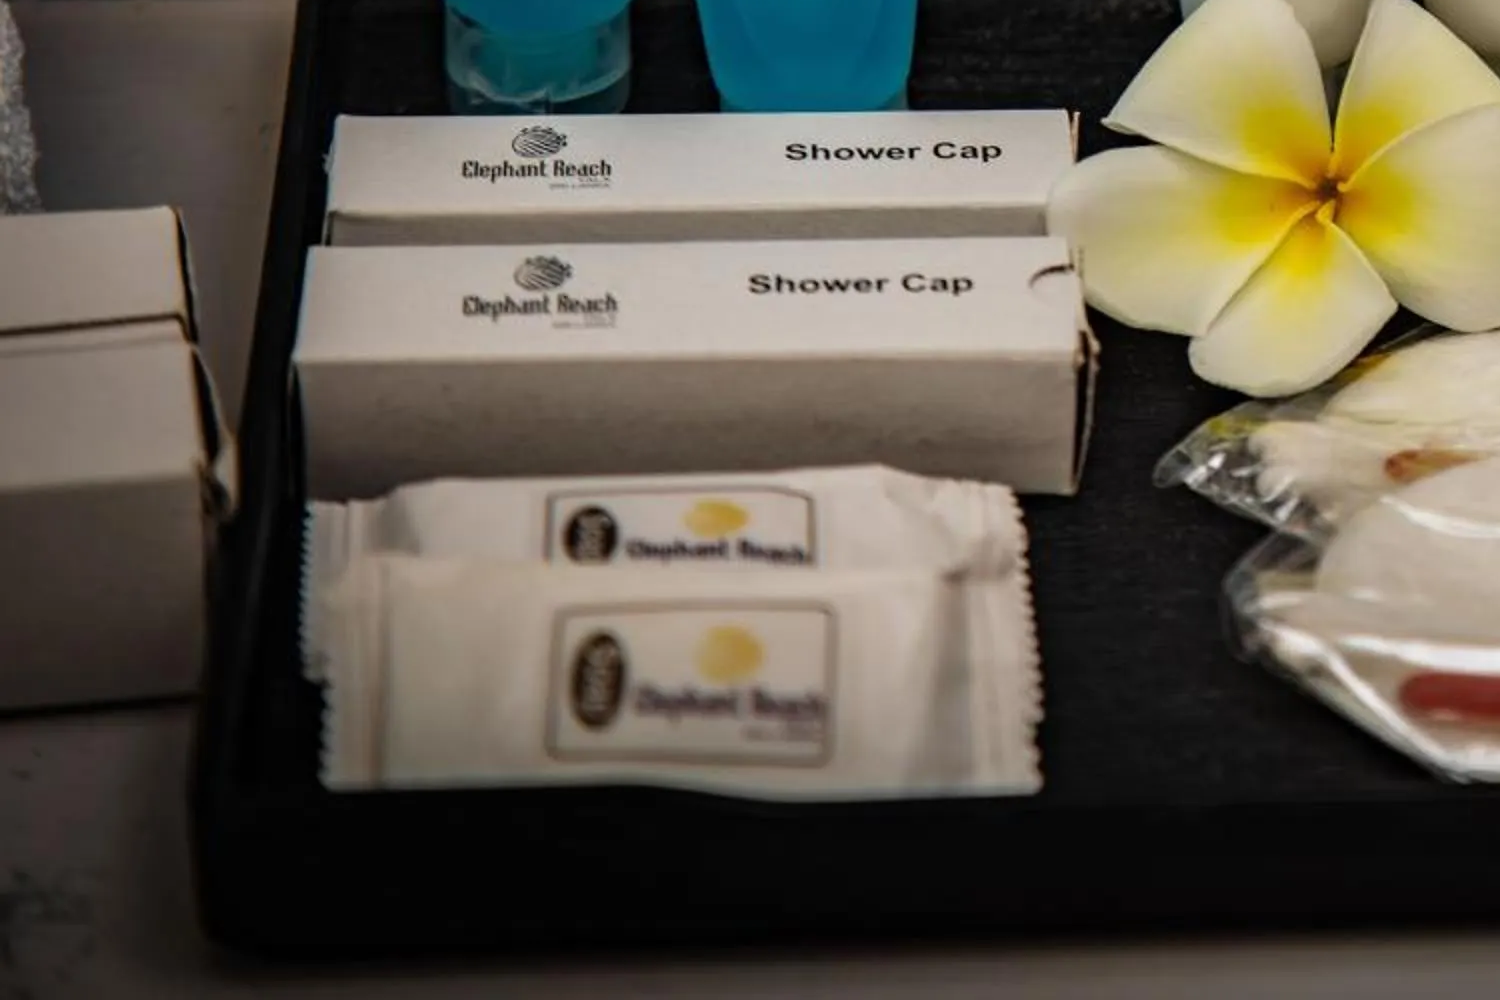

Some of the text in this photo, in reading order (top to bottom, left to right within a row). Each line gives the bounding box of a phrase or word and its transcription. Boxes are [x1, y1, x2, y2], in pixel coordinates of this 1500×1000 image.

[784, 141, 1003, 164] Shower Cap
[461, 158, 613, 184] Elephant Reach
[747, 271, 975, 297] Shower Cap
